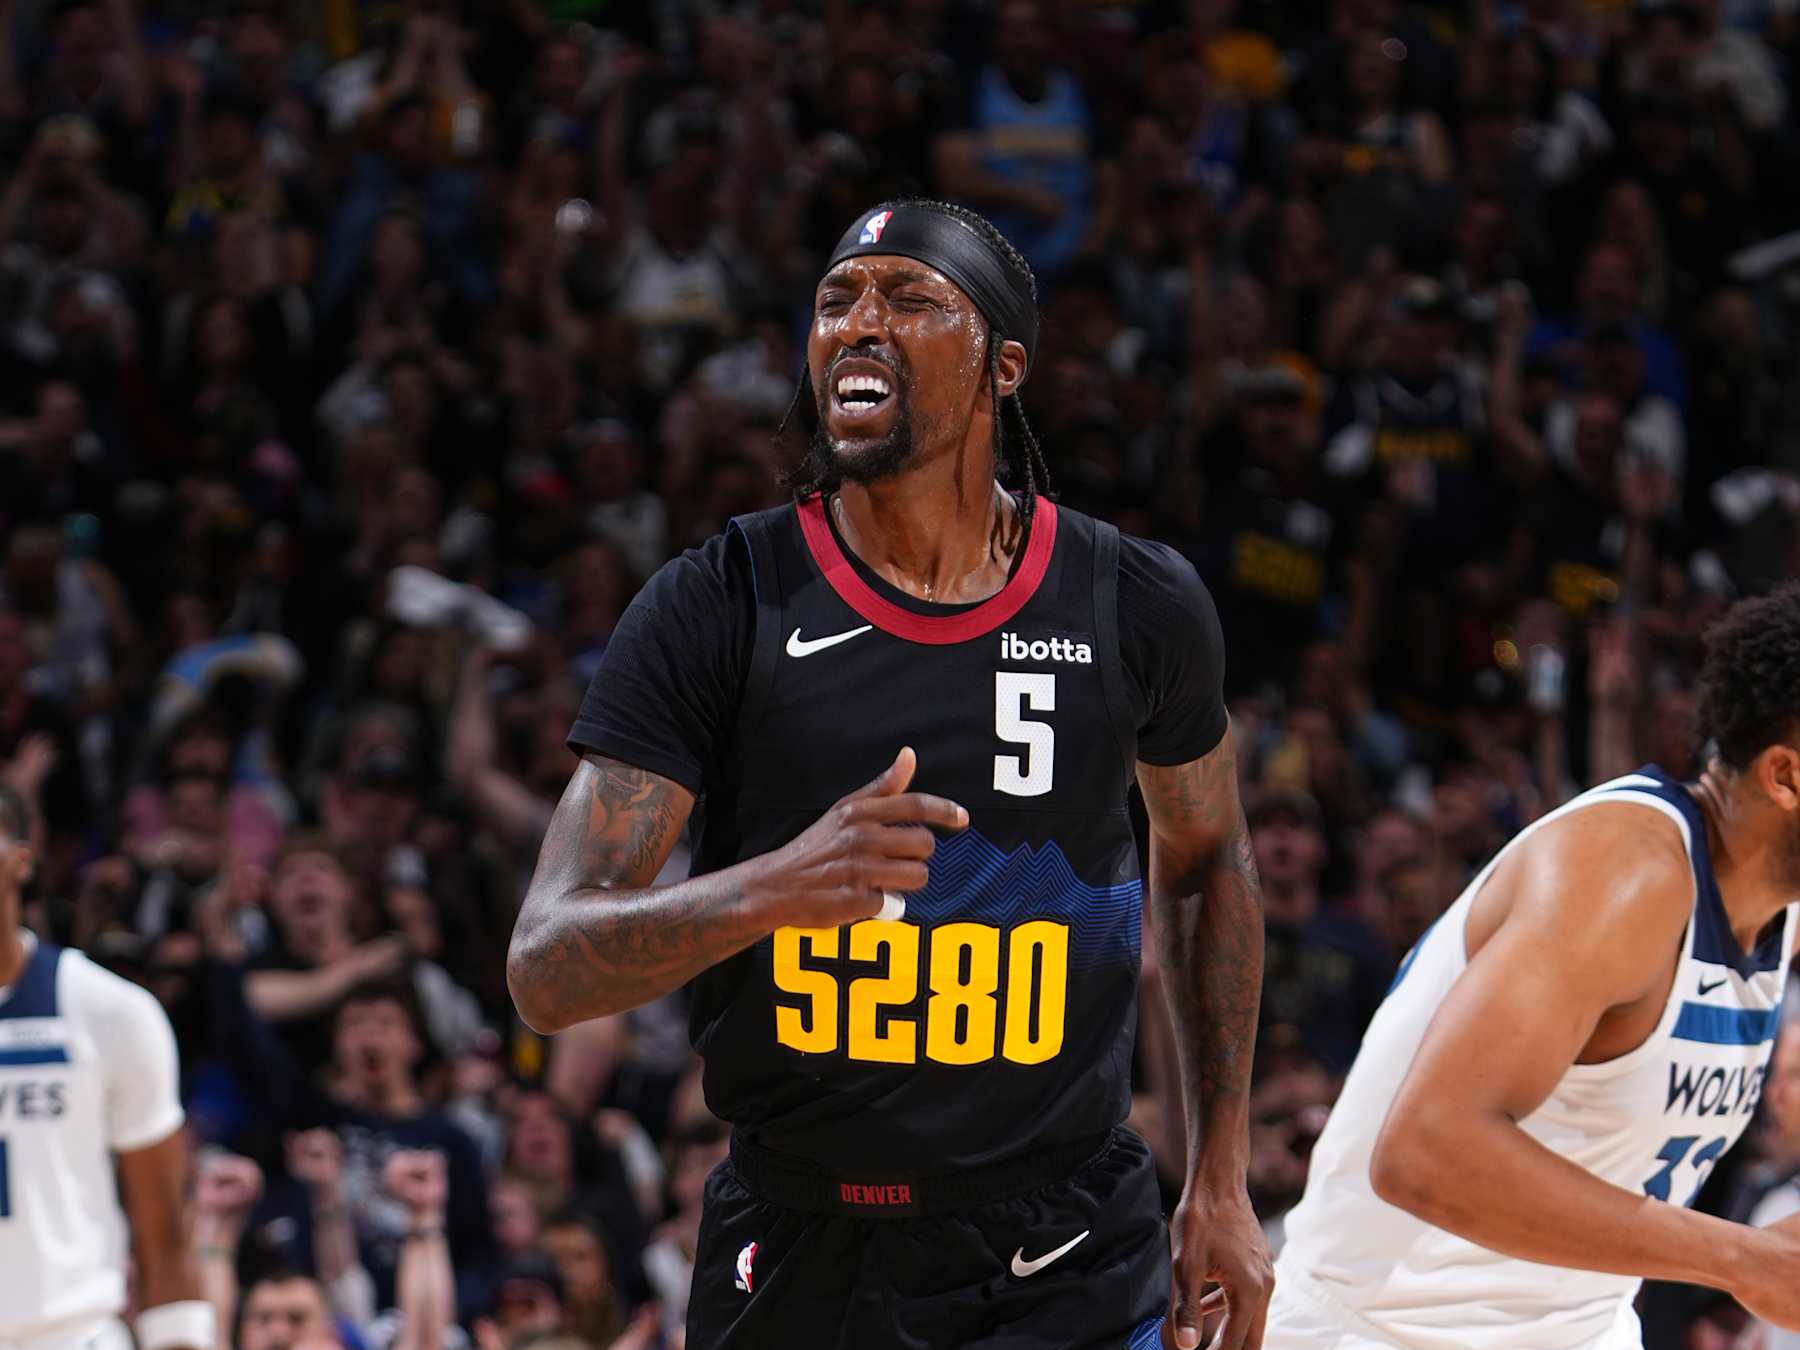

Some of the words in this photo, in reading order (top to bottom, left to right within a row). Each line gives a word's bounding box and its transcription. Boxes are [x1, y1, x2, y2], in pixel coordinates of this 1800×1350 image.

[1001, 631, 1092, 664] ibotta
[993, 671, 1056, 797] 5
[840, 1183, 912, 1205] DENVER
